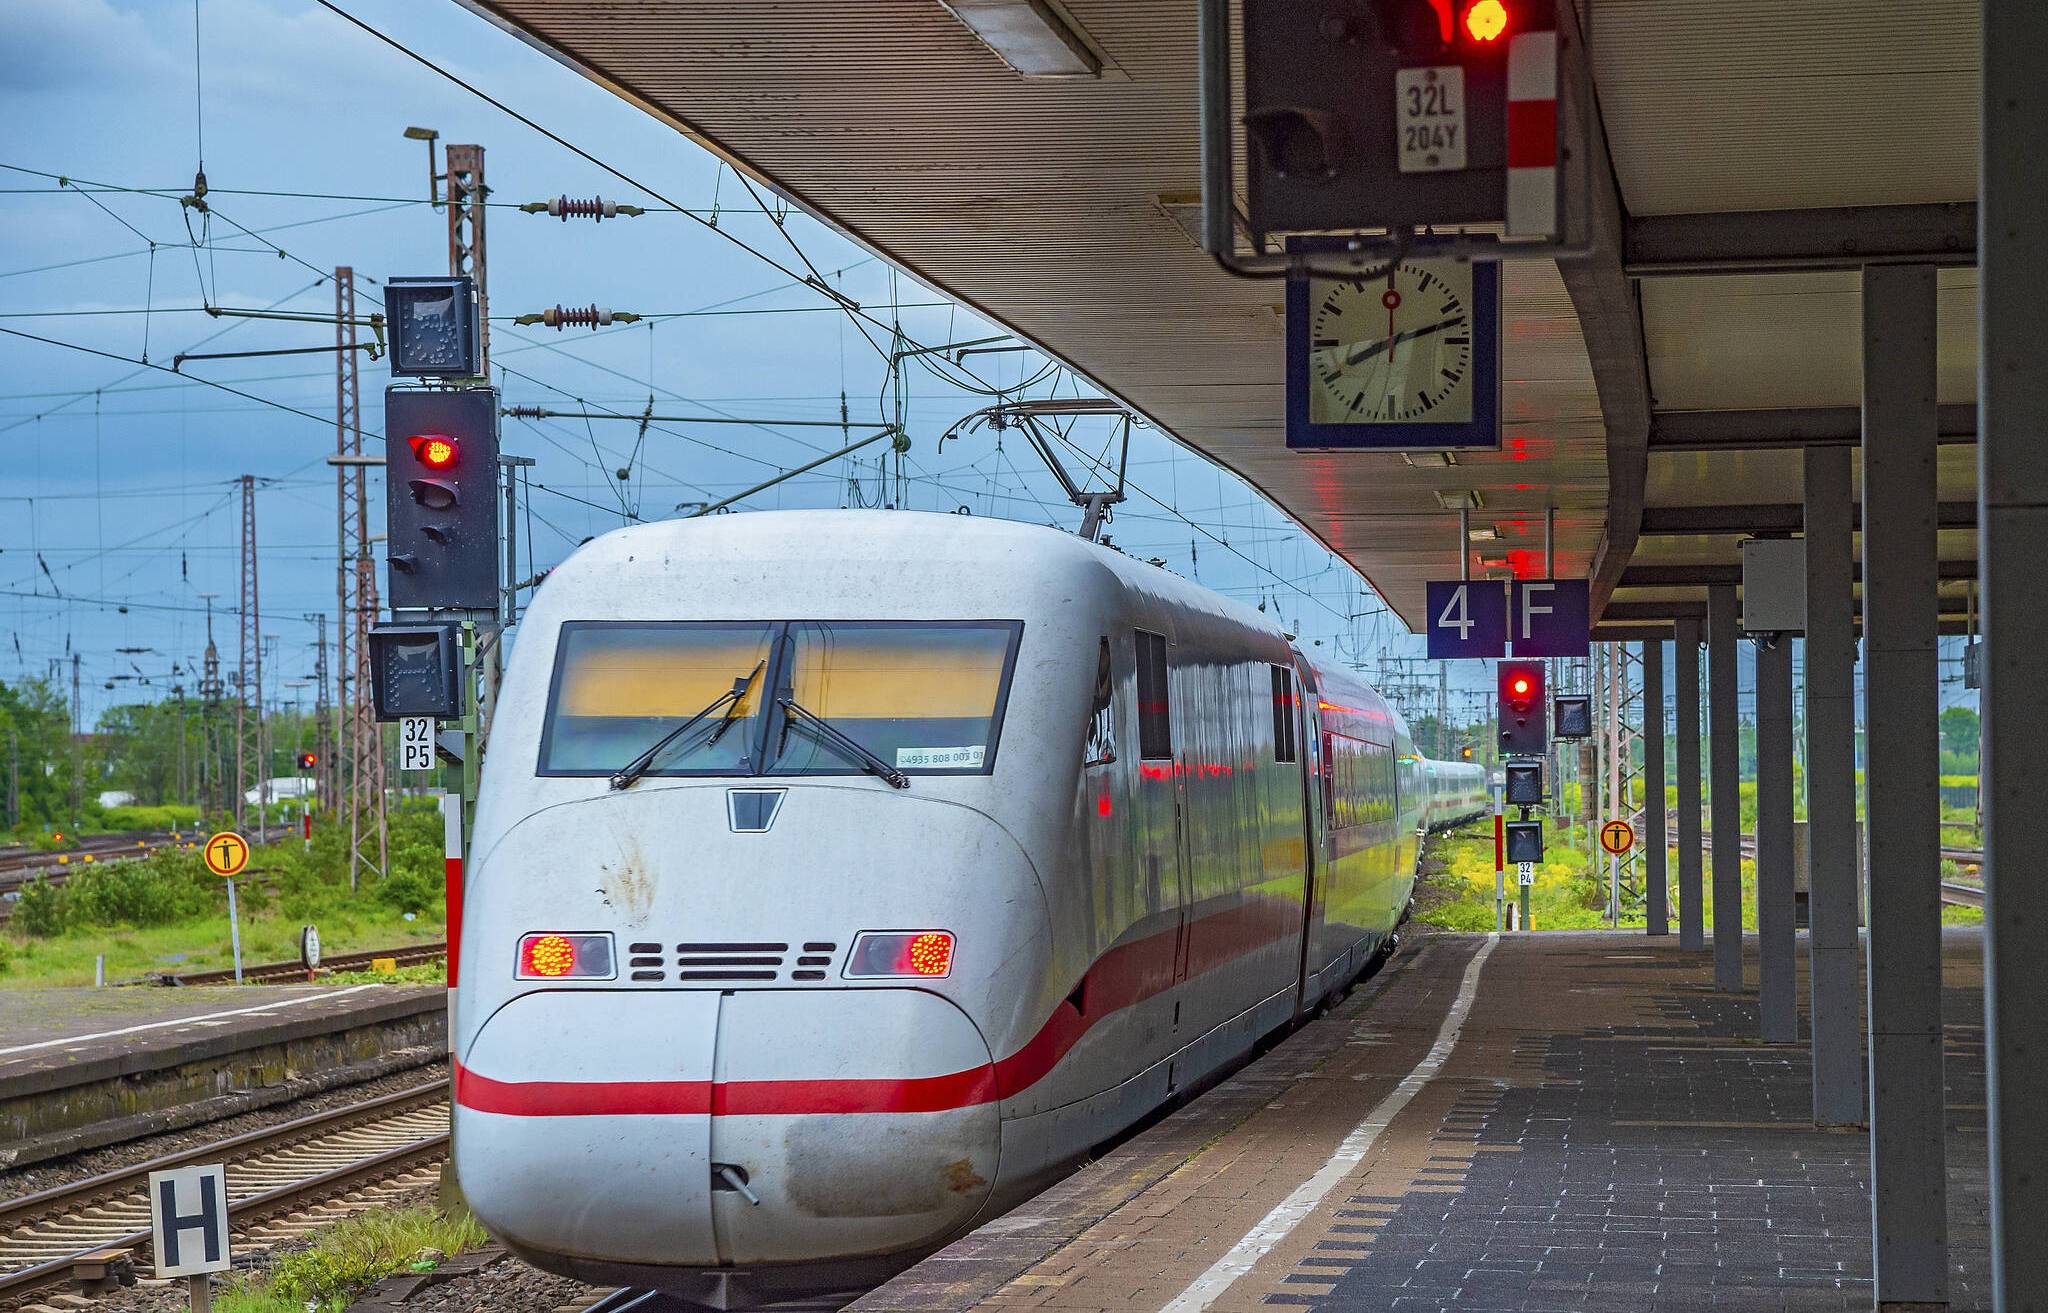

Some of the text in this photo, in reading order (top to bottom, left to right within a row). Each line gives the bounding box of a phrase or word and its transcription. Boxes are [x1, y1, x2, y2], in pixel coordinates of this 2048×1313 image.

[1407, 84, 1455, 117] 32L
[1405, 124, 1457, 151] 204Y
[1438, 584, 1475, 640] 4
[1522, 583, 1555, 639] F
[405, 718, 428, 741] 32
[406, 745, 429, 768] P5
[1520, 862, 1531, 873] 32
[1520, 874, 1531, 884] P4
[160, 1175, 220, 1267] H
